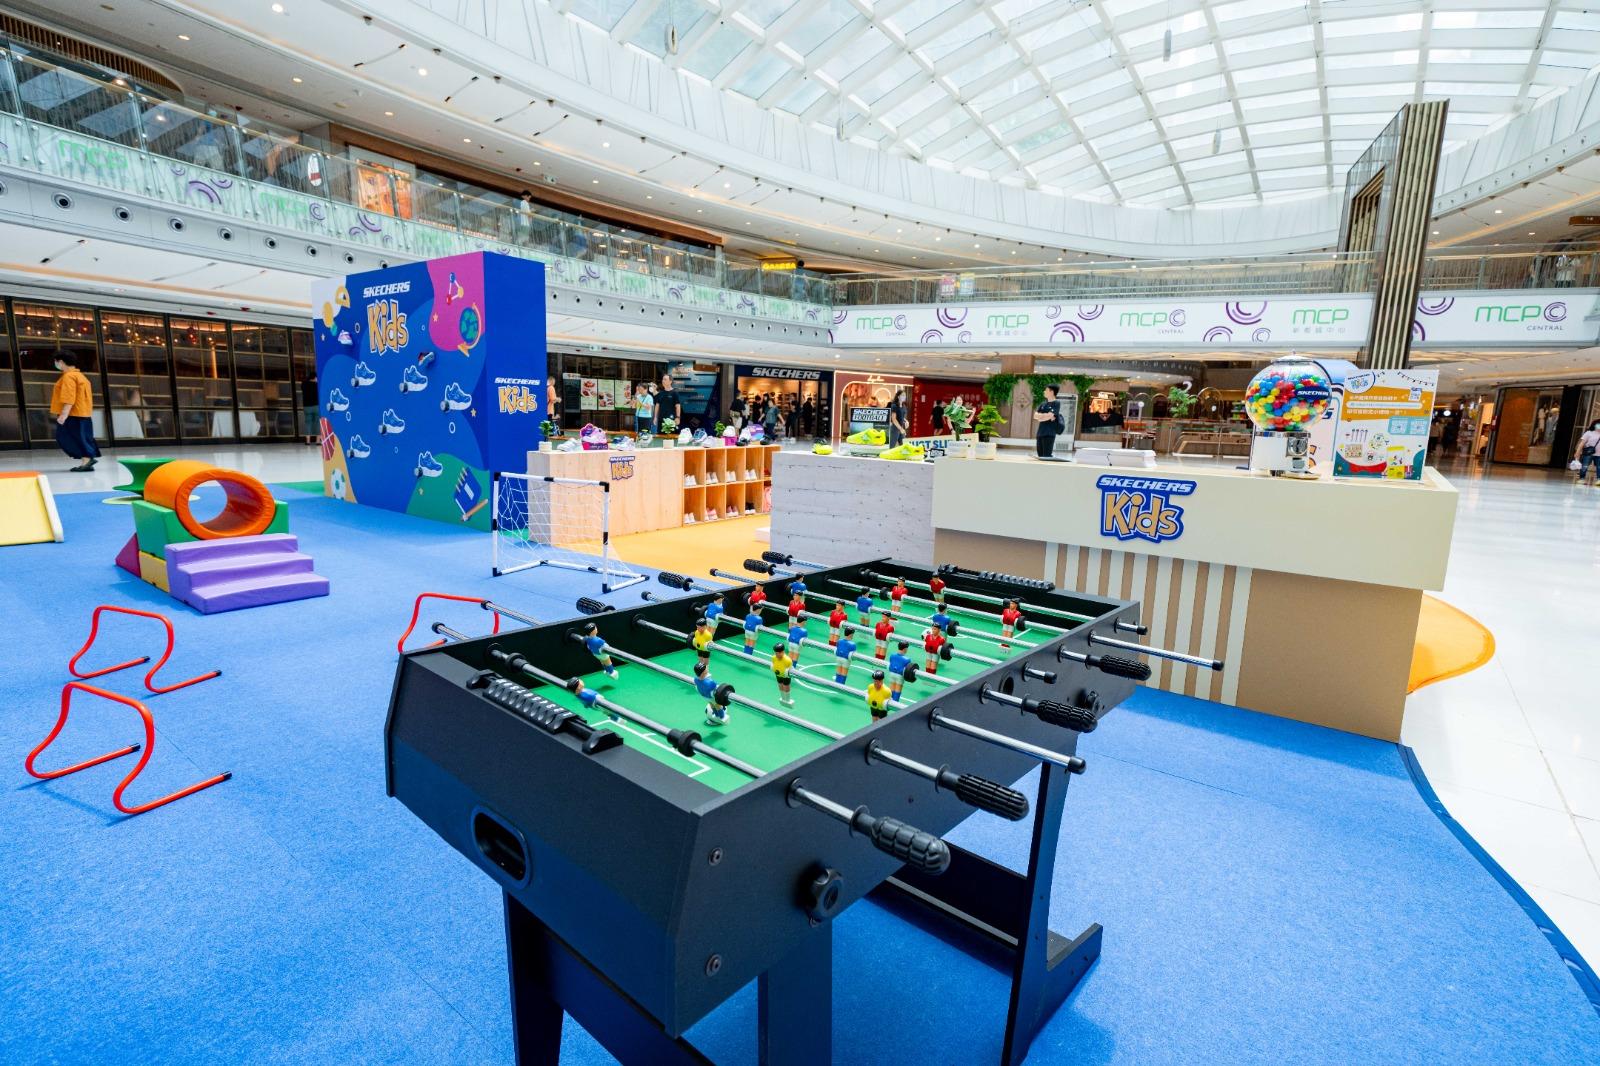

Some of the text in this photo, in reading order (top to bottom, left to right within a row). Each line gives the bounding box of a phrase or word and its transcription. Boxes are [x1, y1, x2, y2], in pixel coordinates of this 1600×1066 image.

[363, 281, 411, 298] SKECHERS
[367, 299, 409, 356] Kids
[494, 377, 541, 386] SKECHERS
[752, 367, 821, 380] SKECHERS
[498, 385, 537, 414] Kids
[1098, 476, 1194, 493] SKECHERS
[1104, 490, 1180, 540] Kids
